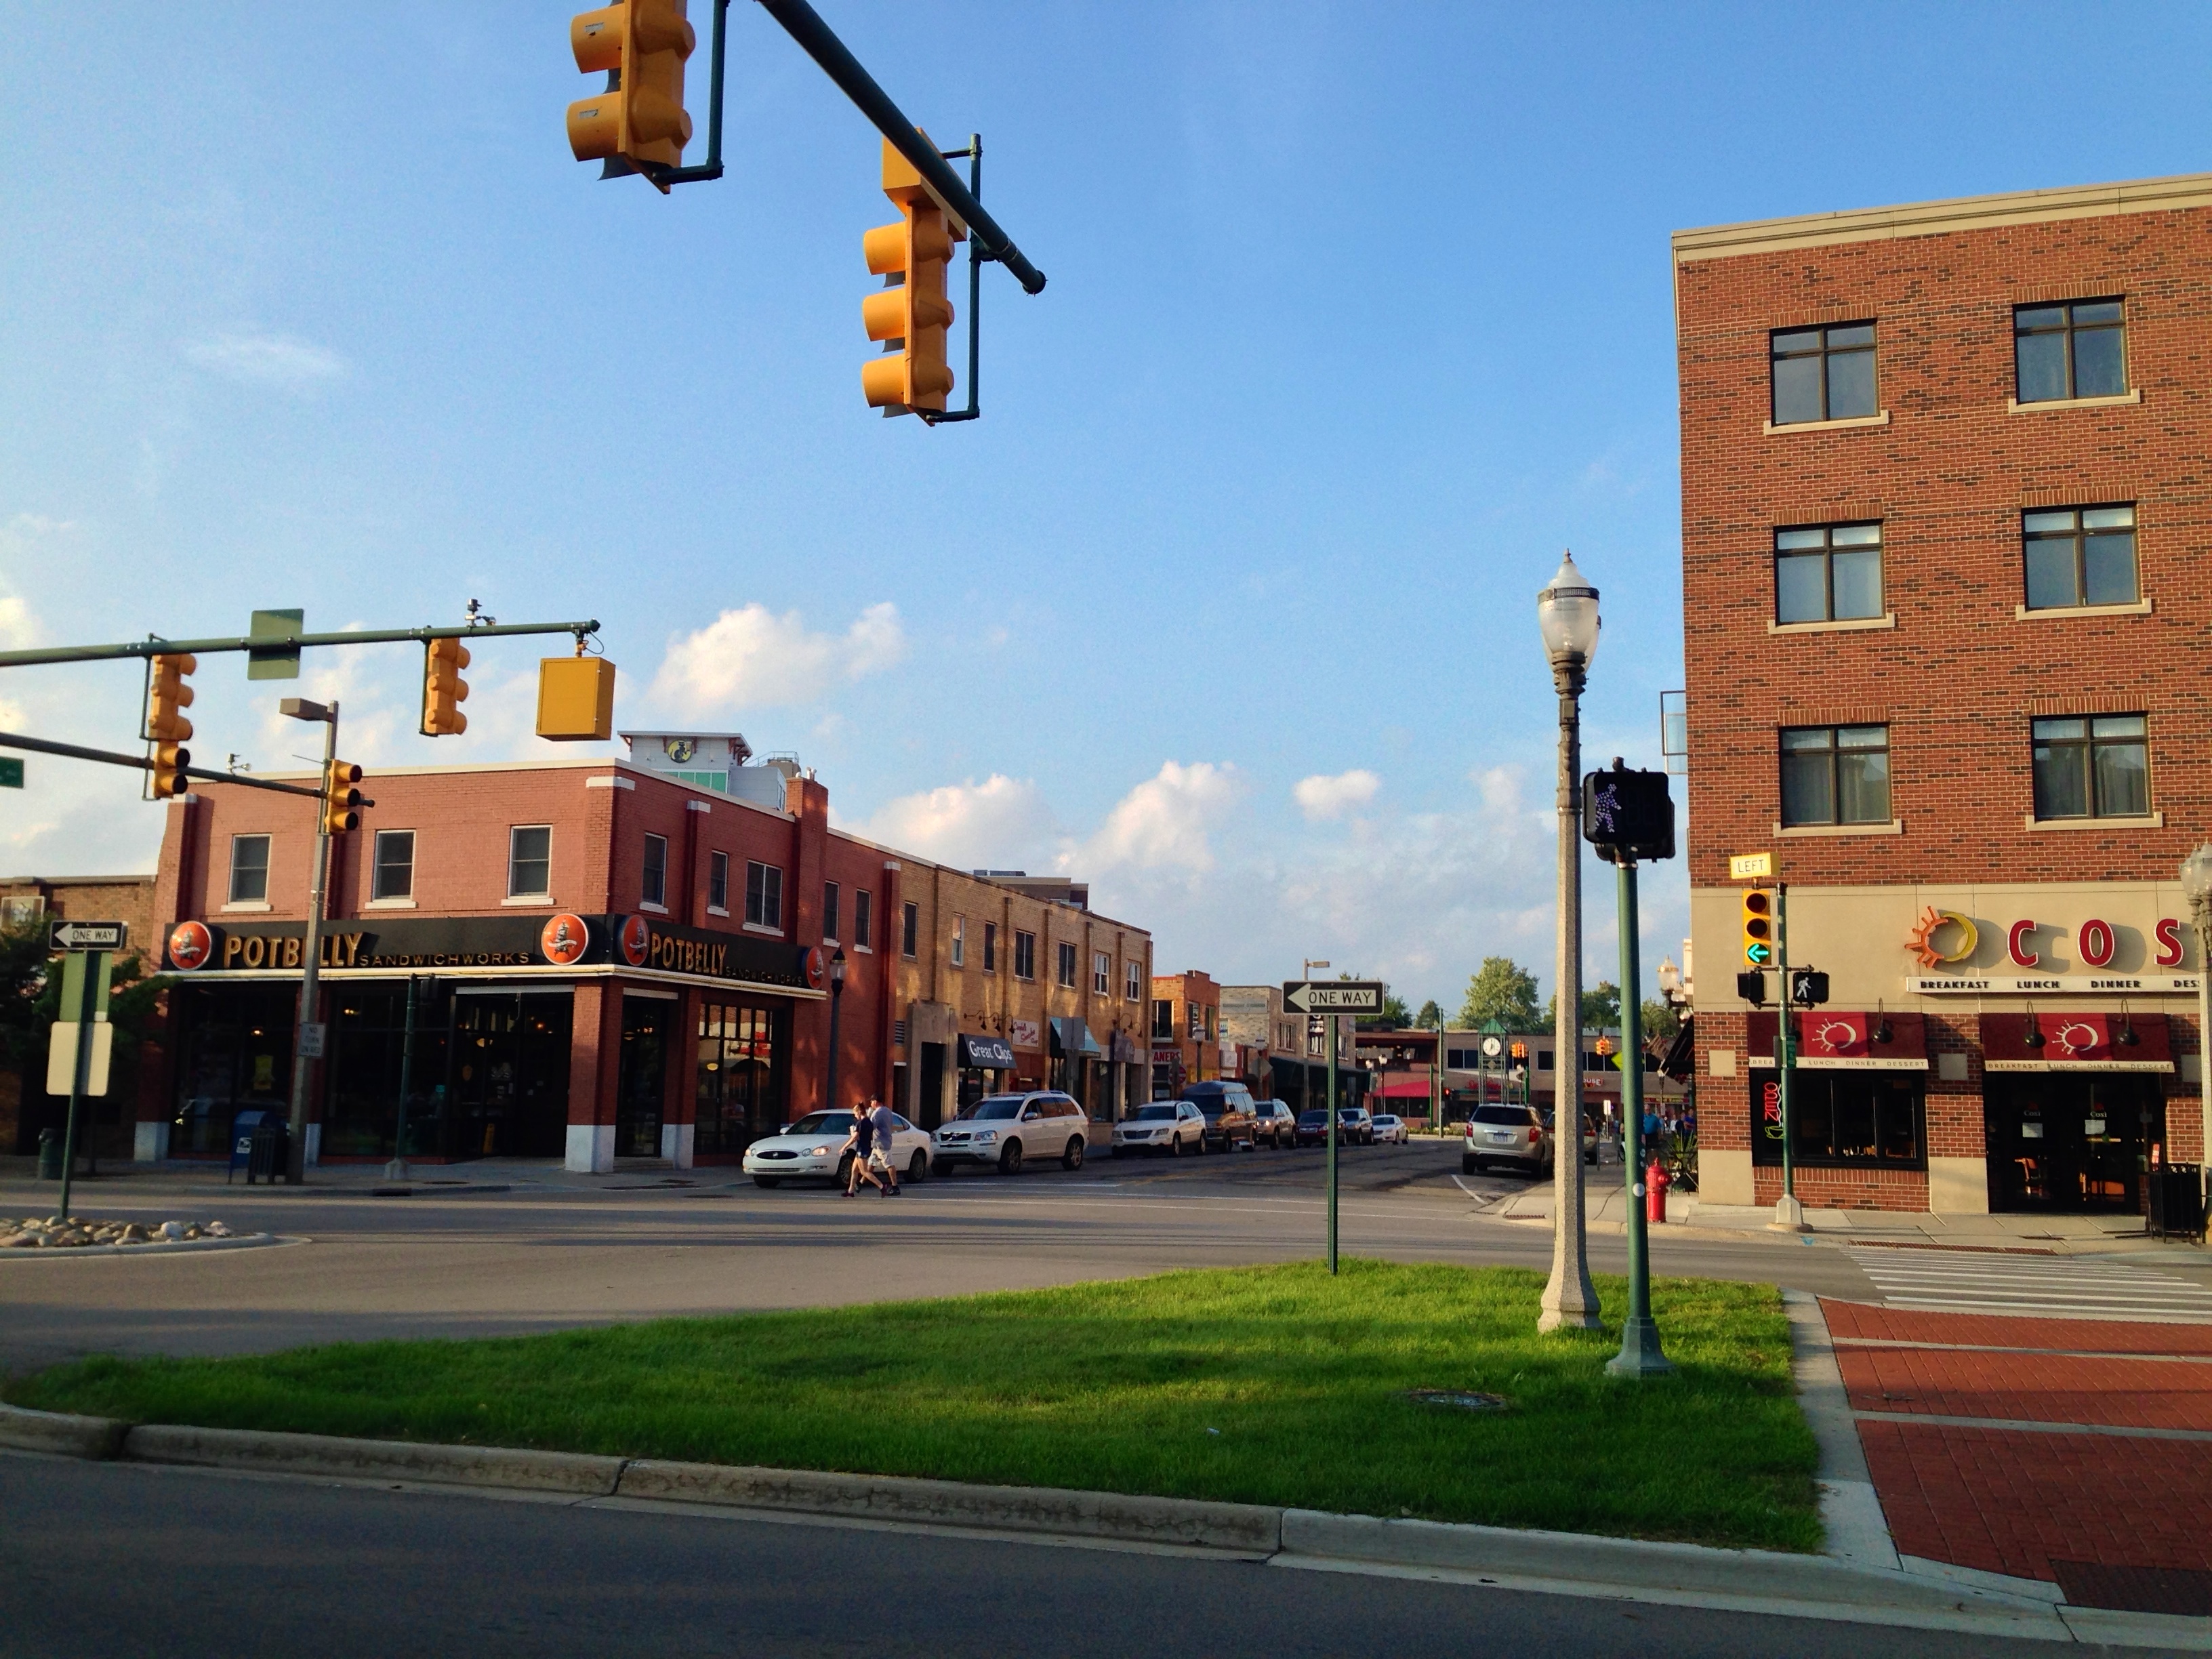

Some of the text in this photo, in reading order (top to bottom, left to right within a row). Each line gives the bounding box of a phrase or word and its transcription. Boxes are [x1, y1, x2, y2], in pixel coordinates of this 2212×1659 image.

[1738, 859, 1764, 873] LEFT
[73, 930, 115, 941] ONE WAY
[224, 931, 529, 968] POTBLLY SANDWICHWORKS
[651, 933, 727, 975] POTBELLY
[1920, 981, 1990, 989] BREAKFAST
[2017, 981, 2060, 989] LUNCH
[2091, 980, 2142, 988] DINNER
[1309, 991, 1372, 1004] ONE WAY
[969, 1040, 1012, 1065] Great Clips
[1764, 1082, 1780, 1122] OPEN
